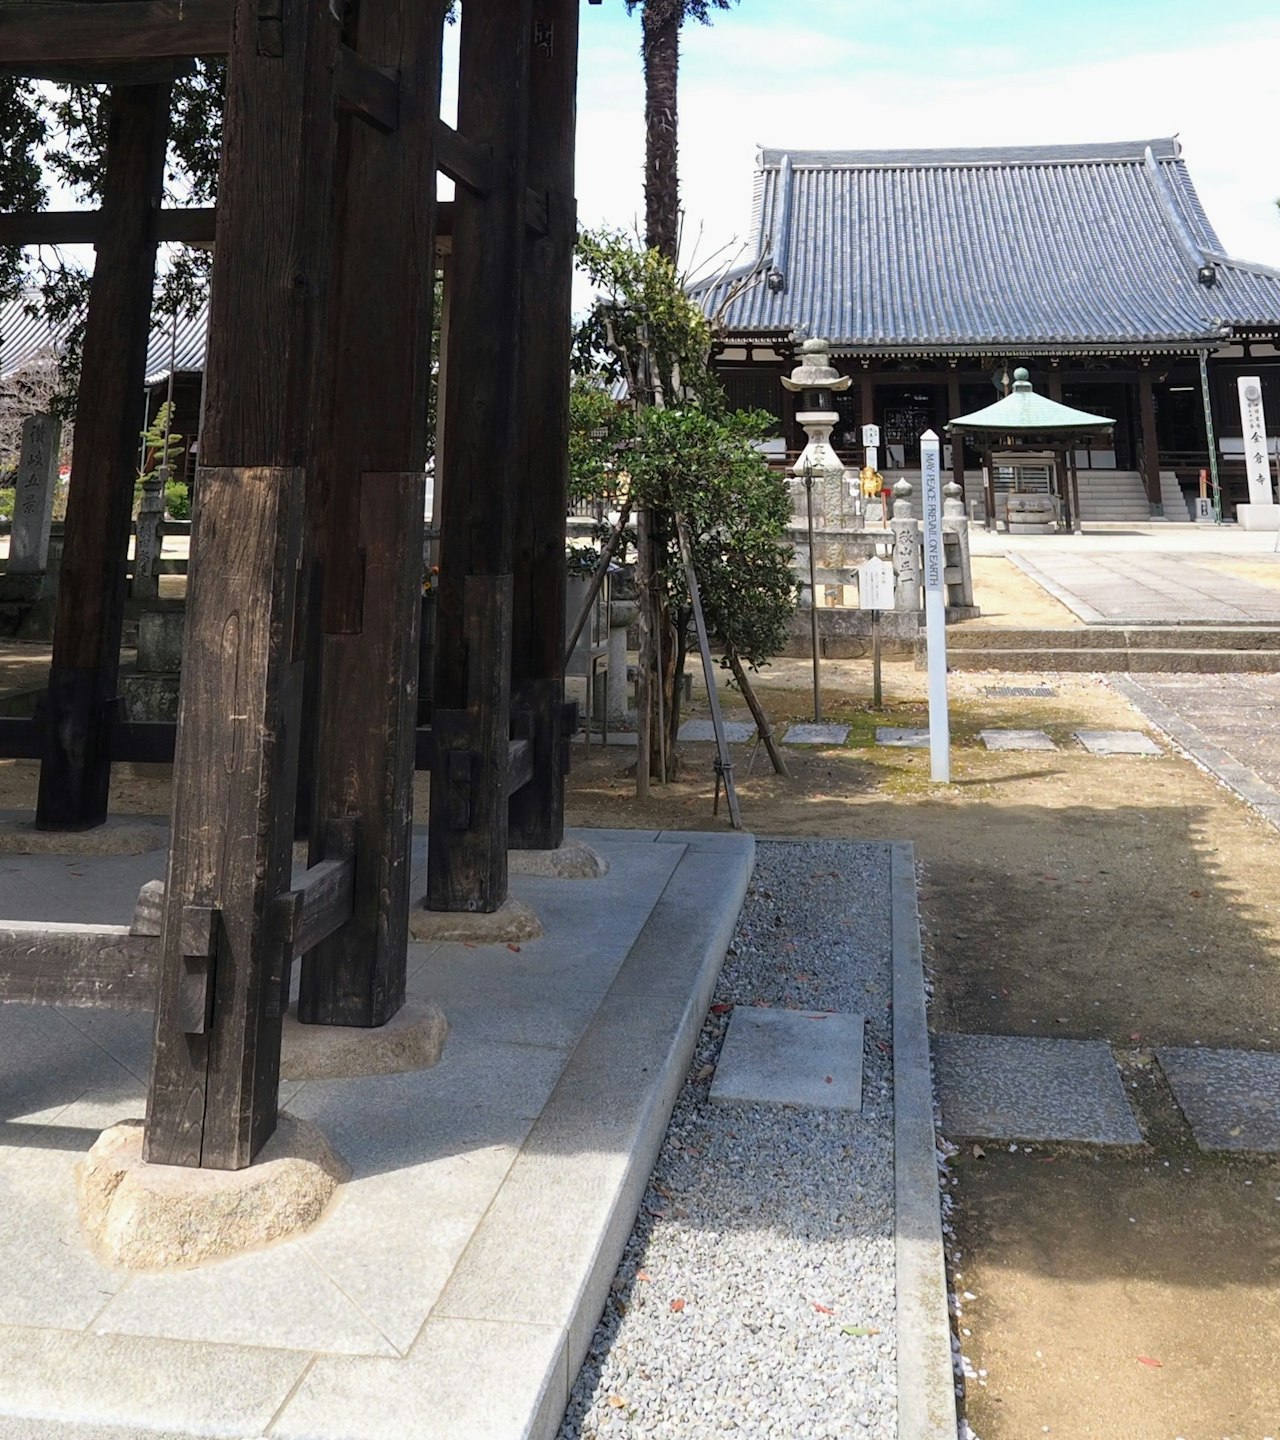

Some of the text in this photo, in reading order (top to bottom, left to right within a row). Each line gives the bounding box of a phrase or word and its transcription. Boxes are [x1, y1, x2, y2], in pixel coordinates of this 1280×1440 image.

[1251, 432, 1266, 485] 金倉寺
[925, 453, 939, 587] MAY PEACE PREVAIL ON EARTH
